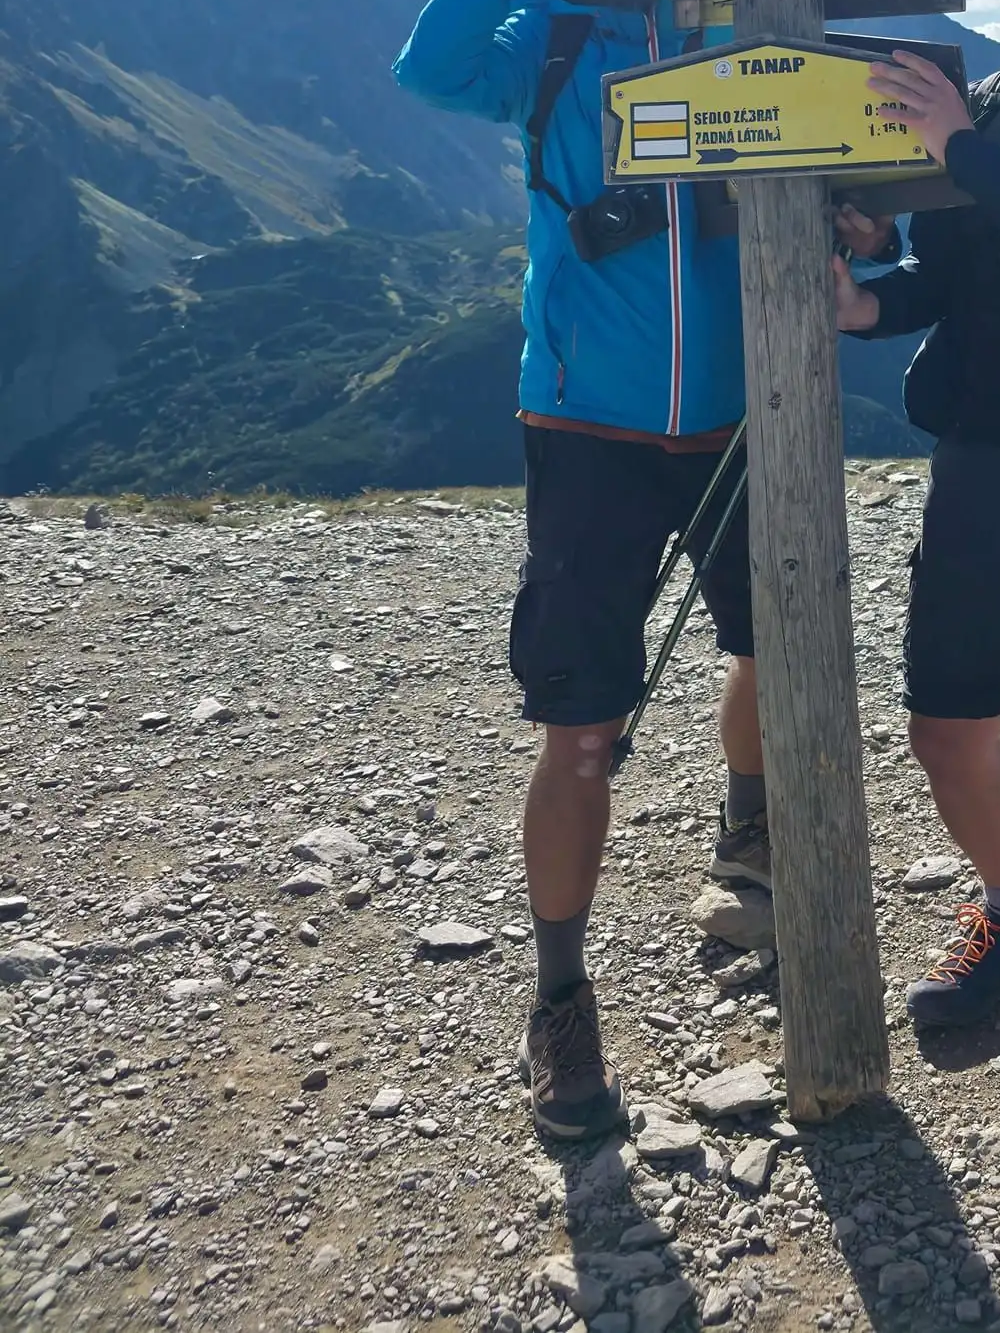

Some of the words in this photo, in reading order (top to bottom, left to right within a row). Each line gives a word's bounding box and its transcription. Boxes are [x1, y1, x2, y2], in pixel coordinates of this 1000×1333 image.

[738, 57, 805, 75] TANAP
[694, 110, 731, 125] SEDLO
[695, 128, 735, 145] ZADNÁ
